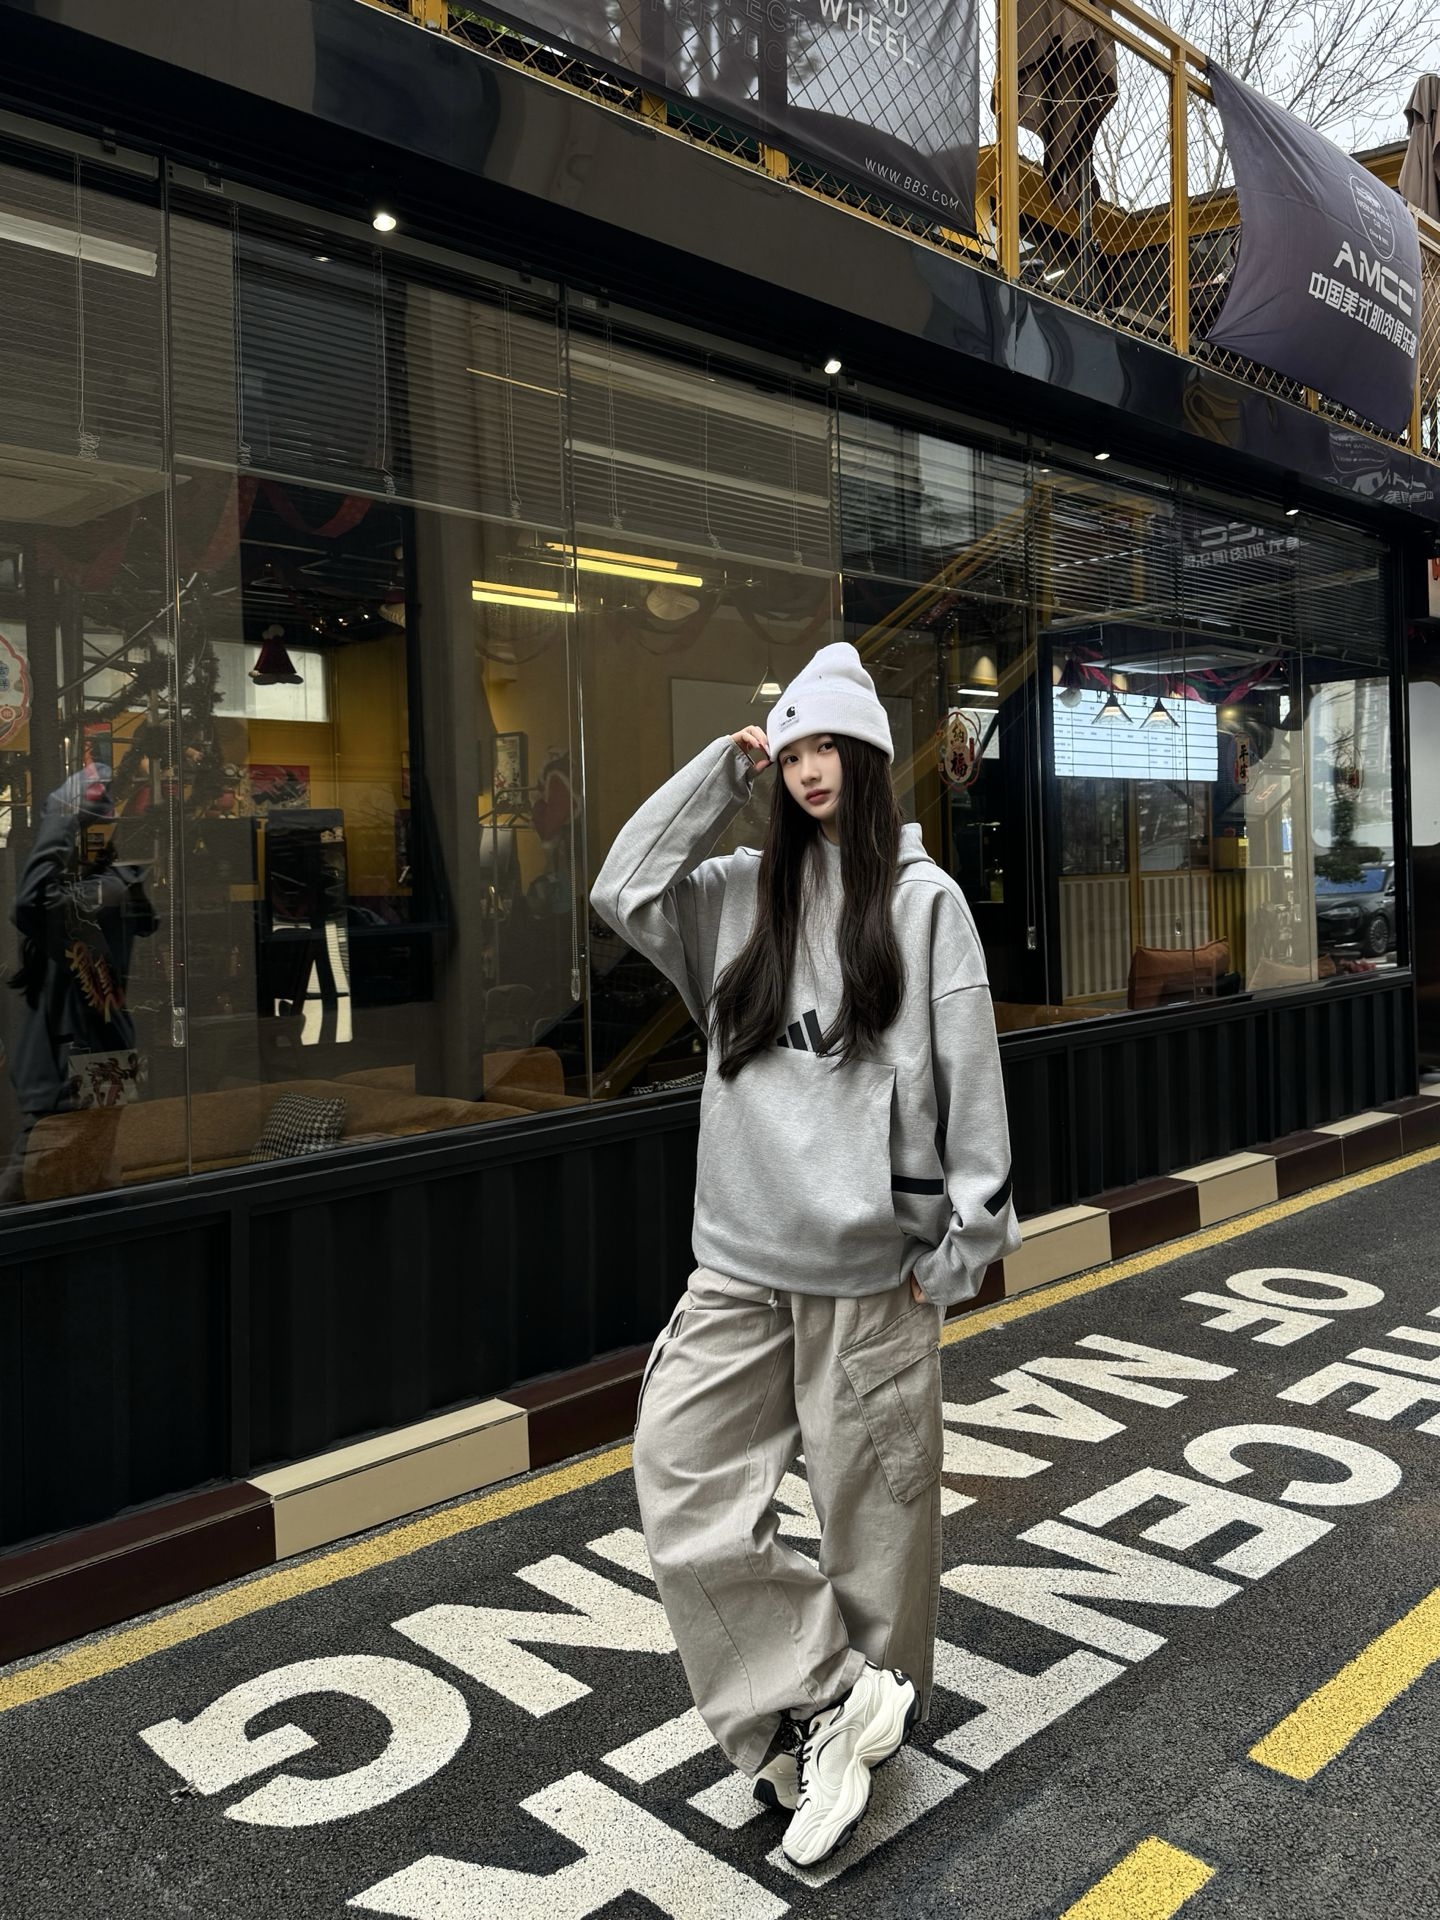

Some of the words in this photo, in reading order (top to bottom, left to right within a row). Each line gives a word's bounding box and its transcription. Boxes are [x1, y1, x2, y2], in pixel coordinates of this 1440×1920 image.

[865, 157, 960, 211] WWW.BBS.COM
[1180, 1267, 1386, 1347] OF
[137, 1333, 1239, 1829] NANG
